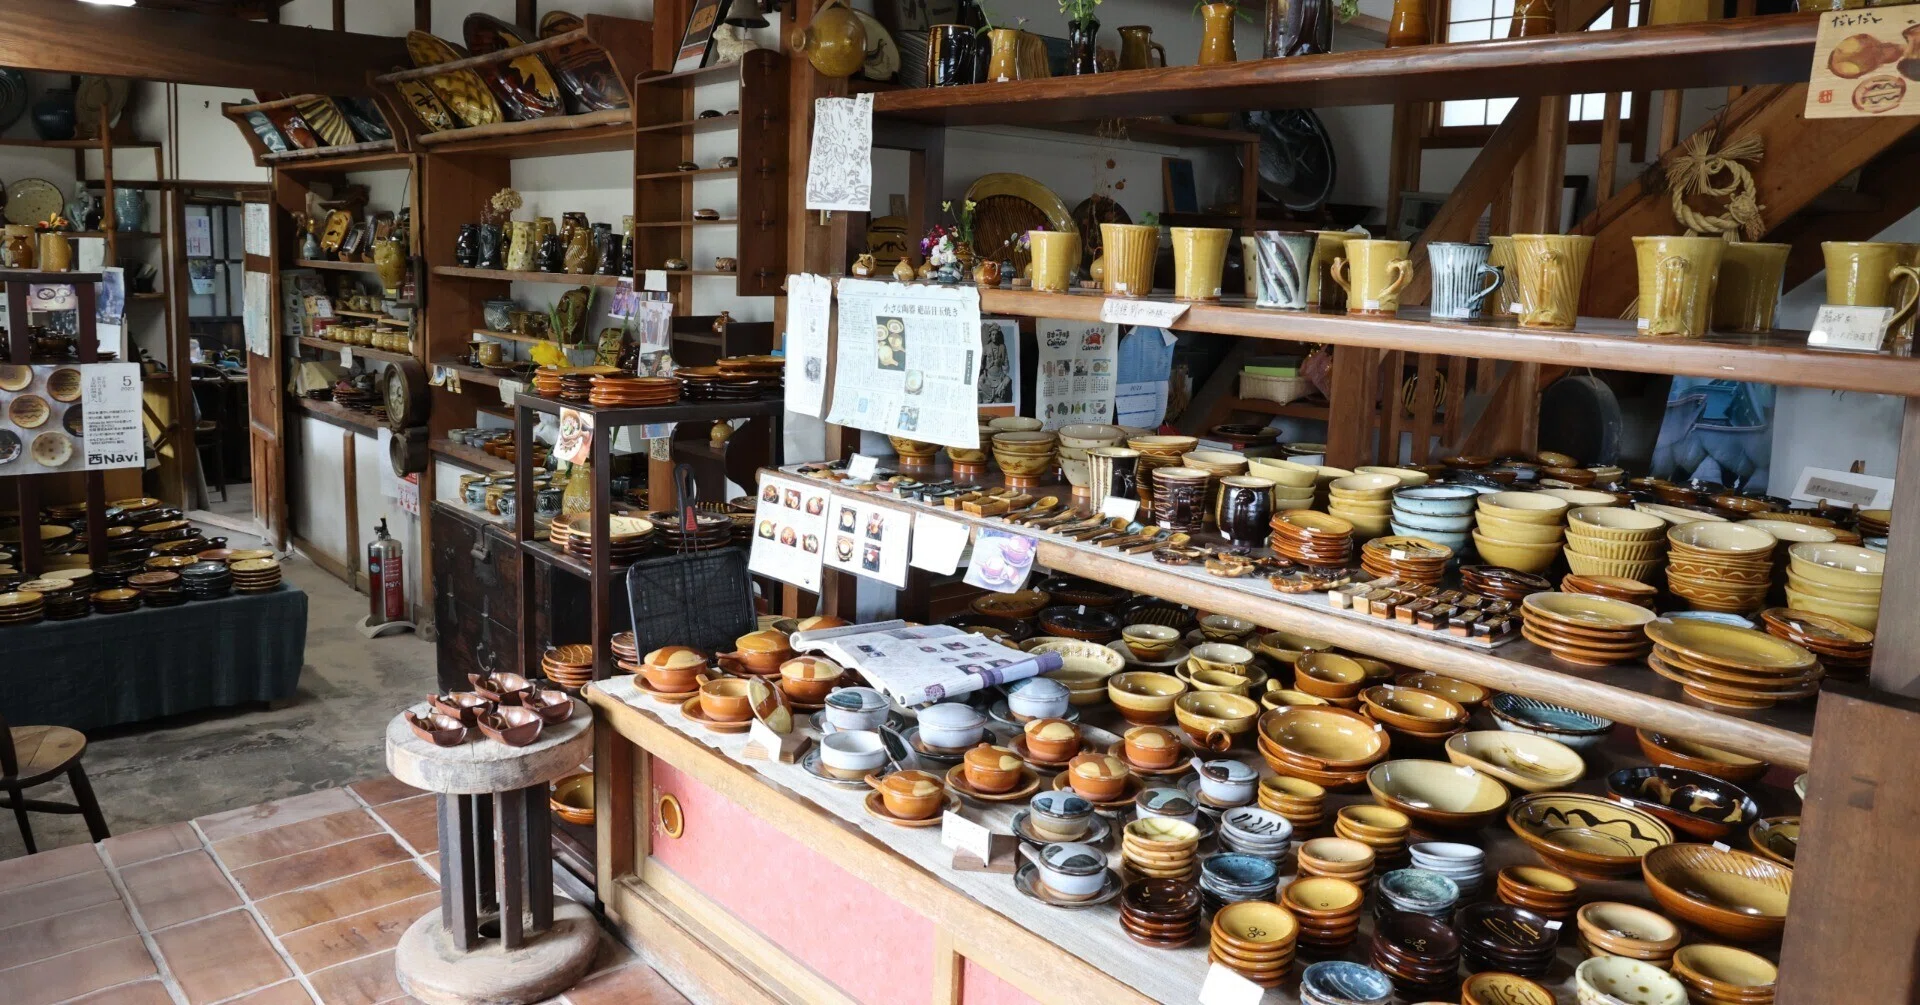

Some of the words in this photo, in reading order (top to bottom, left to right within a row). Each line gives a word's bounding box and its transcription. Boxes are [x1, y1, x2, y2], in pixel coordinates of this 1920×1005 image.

[1832, 13, 1882, 28] だんだん
[123, 375, 132, 386] 5
[88, 452, 138, 466] 西Navi
